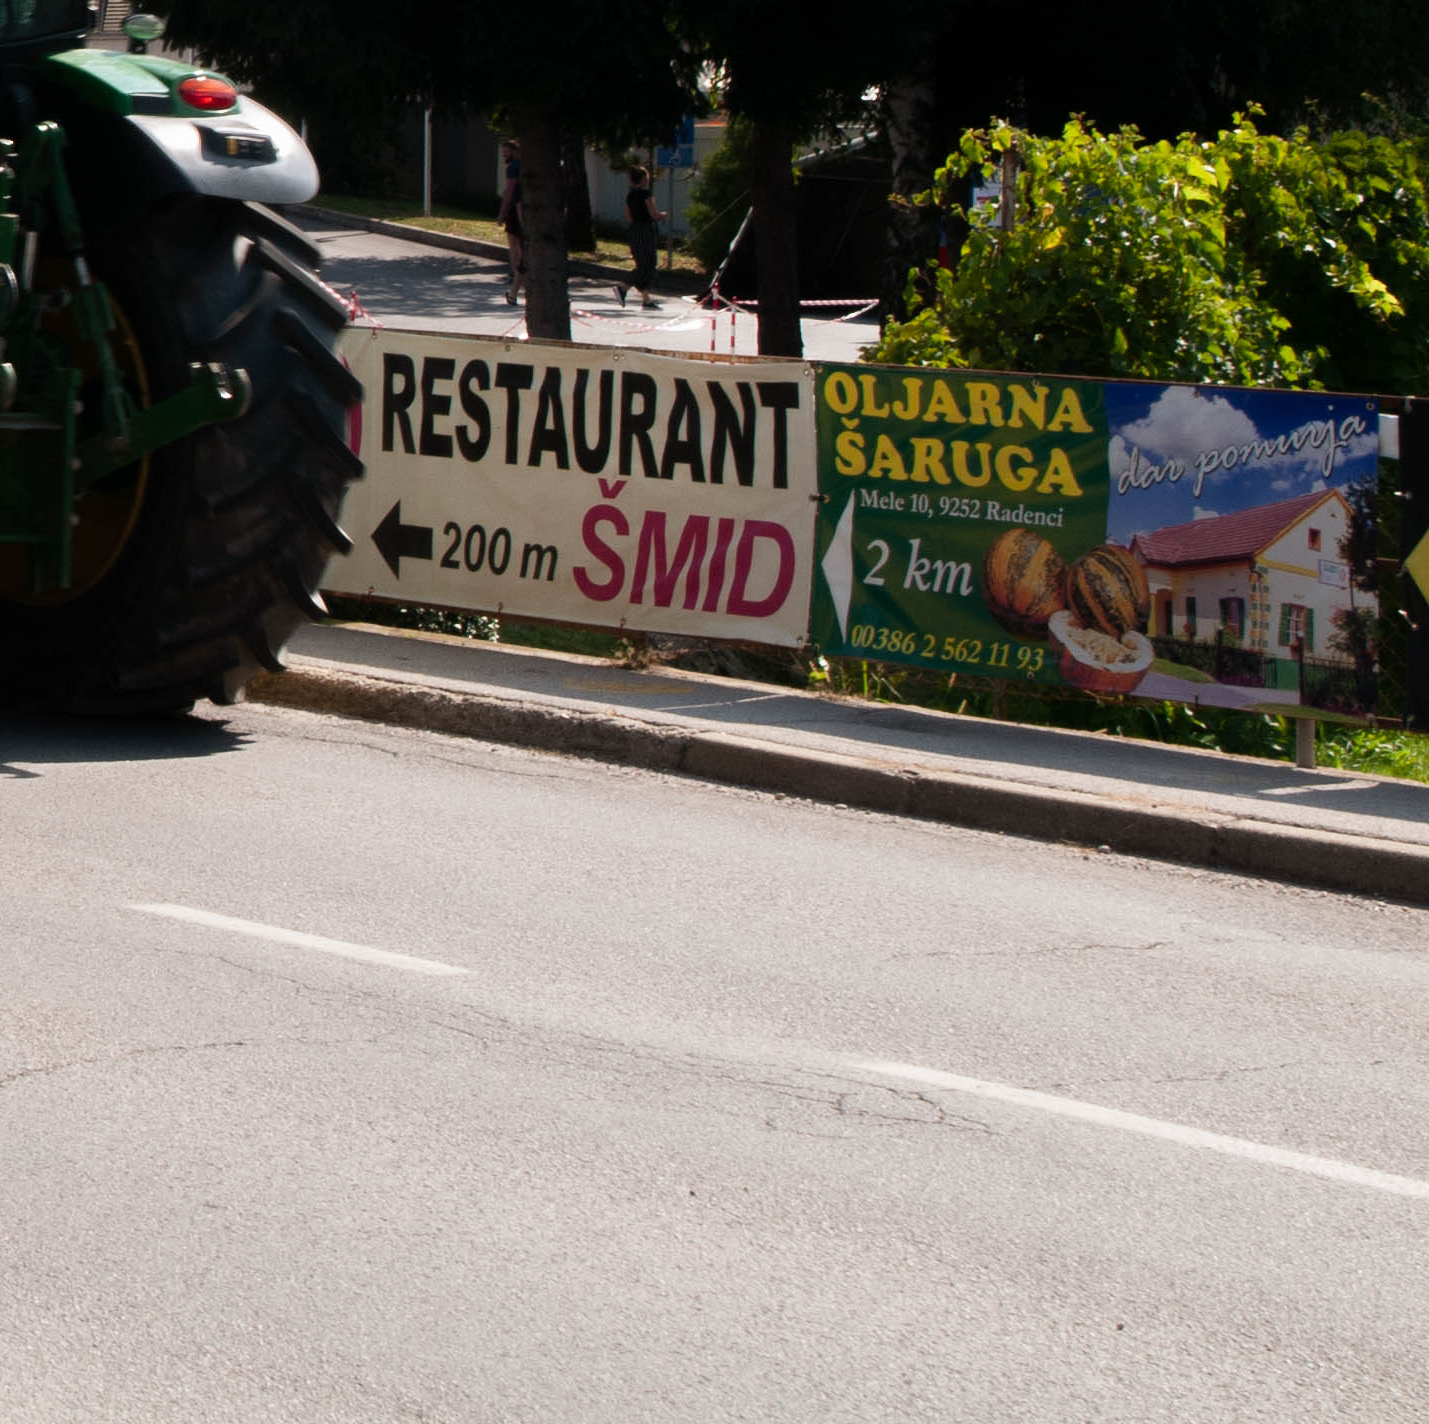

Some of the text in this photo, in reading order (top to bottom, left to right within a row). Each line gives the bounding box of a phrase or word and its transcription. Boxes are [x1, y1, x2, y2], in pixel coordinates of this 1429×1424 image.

[381, 352, 800, 489] RESTAURANT
[823, 371, 1094, 434] OLJARNA
[834, 416, 1084, 497] ŠARUGA
[1116, 404, 1368, 498] dar pomurja
[859, 488, 1064, 527] Mele 10, 9252 Radenci
[440, 521, 559, 582] 200 m
[572, 478, 796, 618] ŠMID
[863, 538, 974, 596] 2 km
[851, 624, 1045, 672] 00386 2 562 11 93
